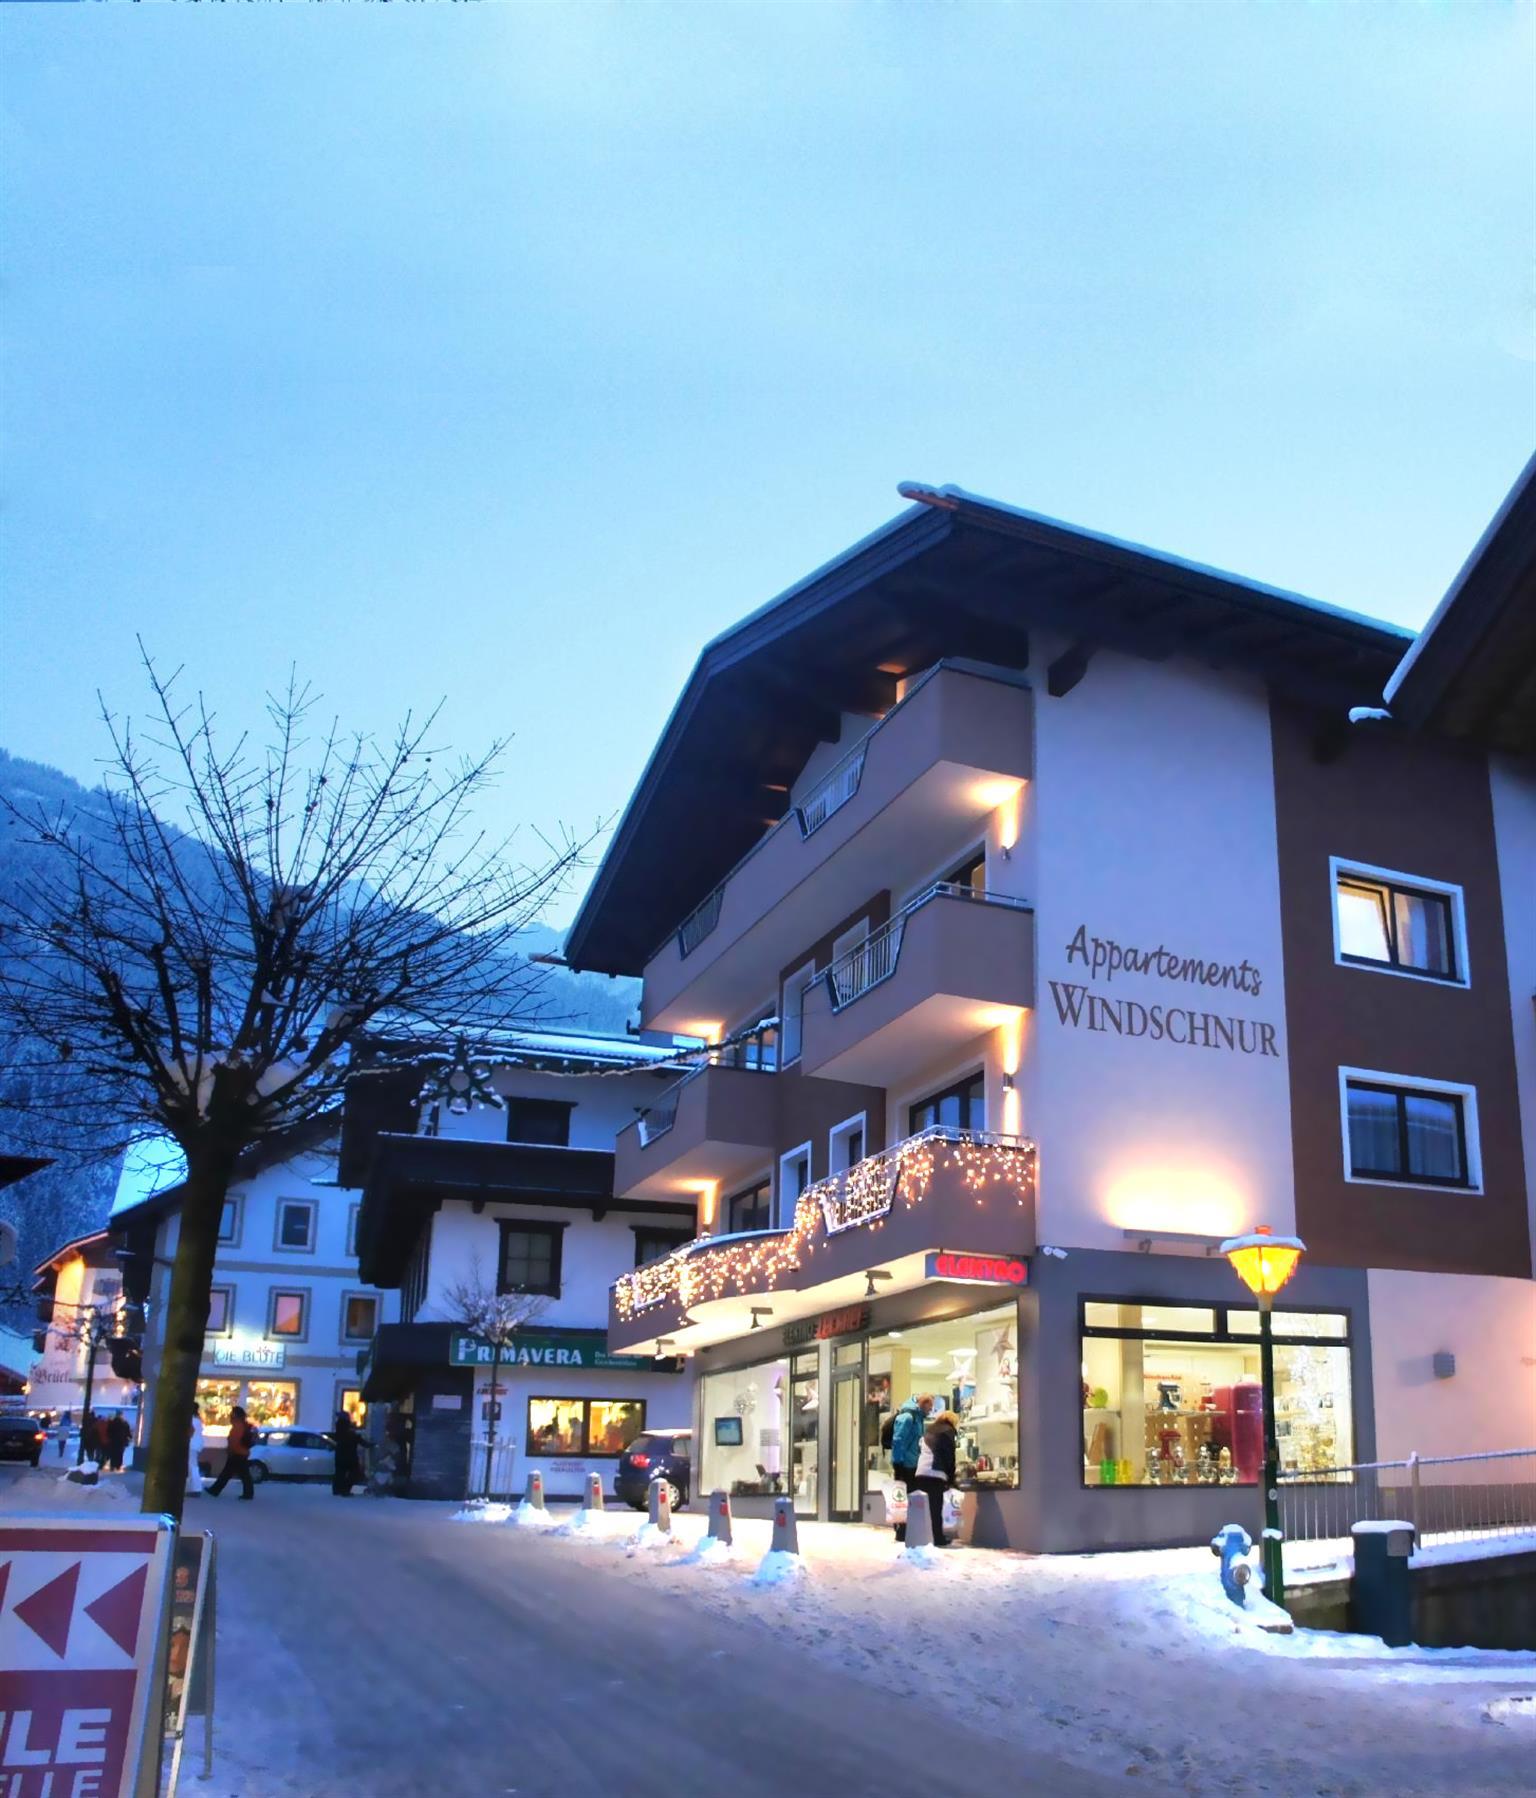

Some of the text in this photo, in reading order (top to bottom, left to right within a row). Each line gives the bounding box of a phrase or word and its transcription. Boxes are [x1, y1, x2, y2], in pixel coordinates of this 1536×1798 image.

[1066, 924, 1262, 996] Appartements
[1048, 980, 1280, 1057] WINDSCHNUR
[0, 1708, 112, 1766] LE
